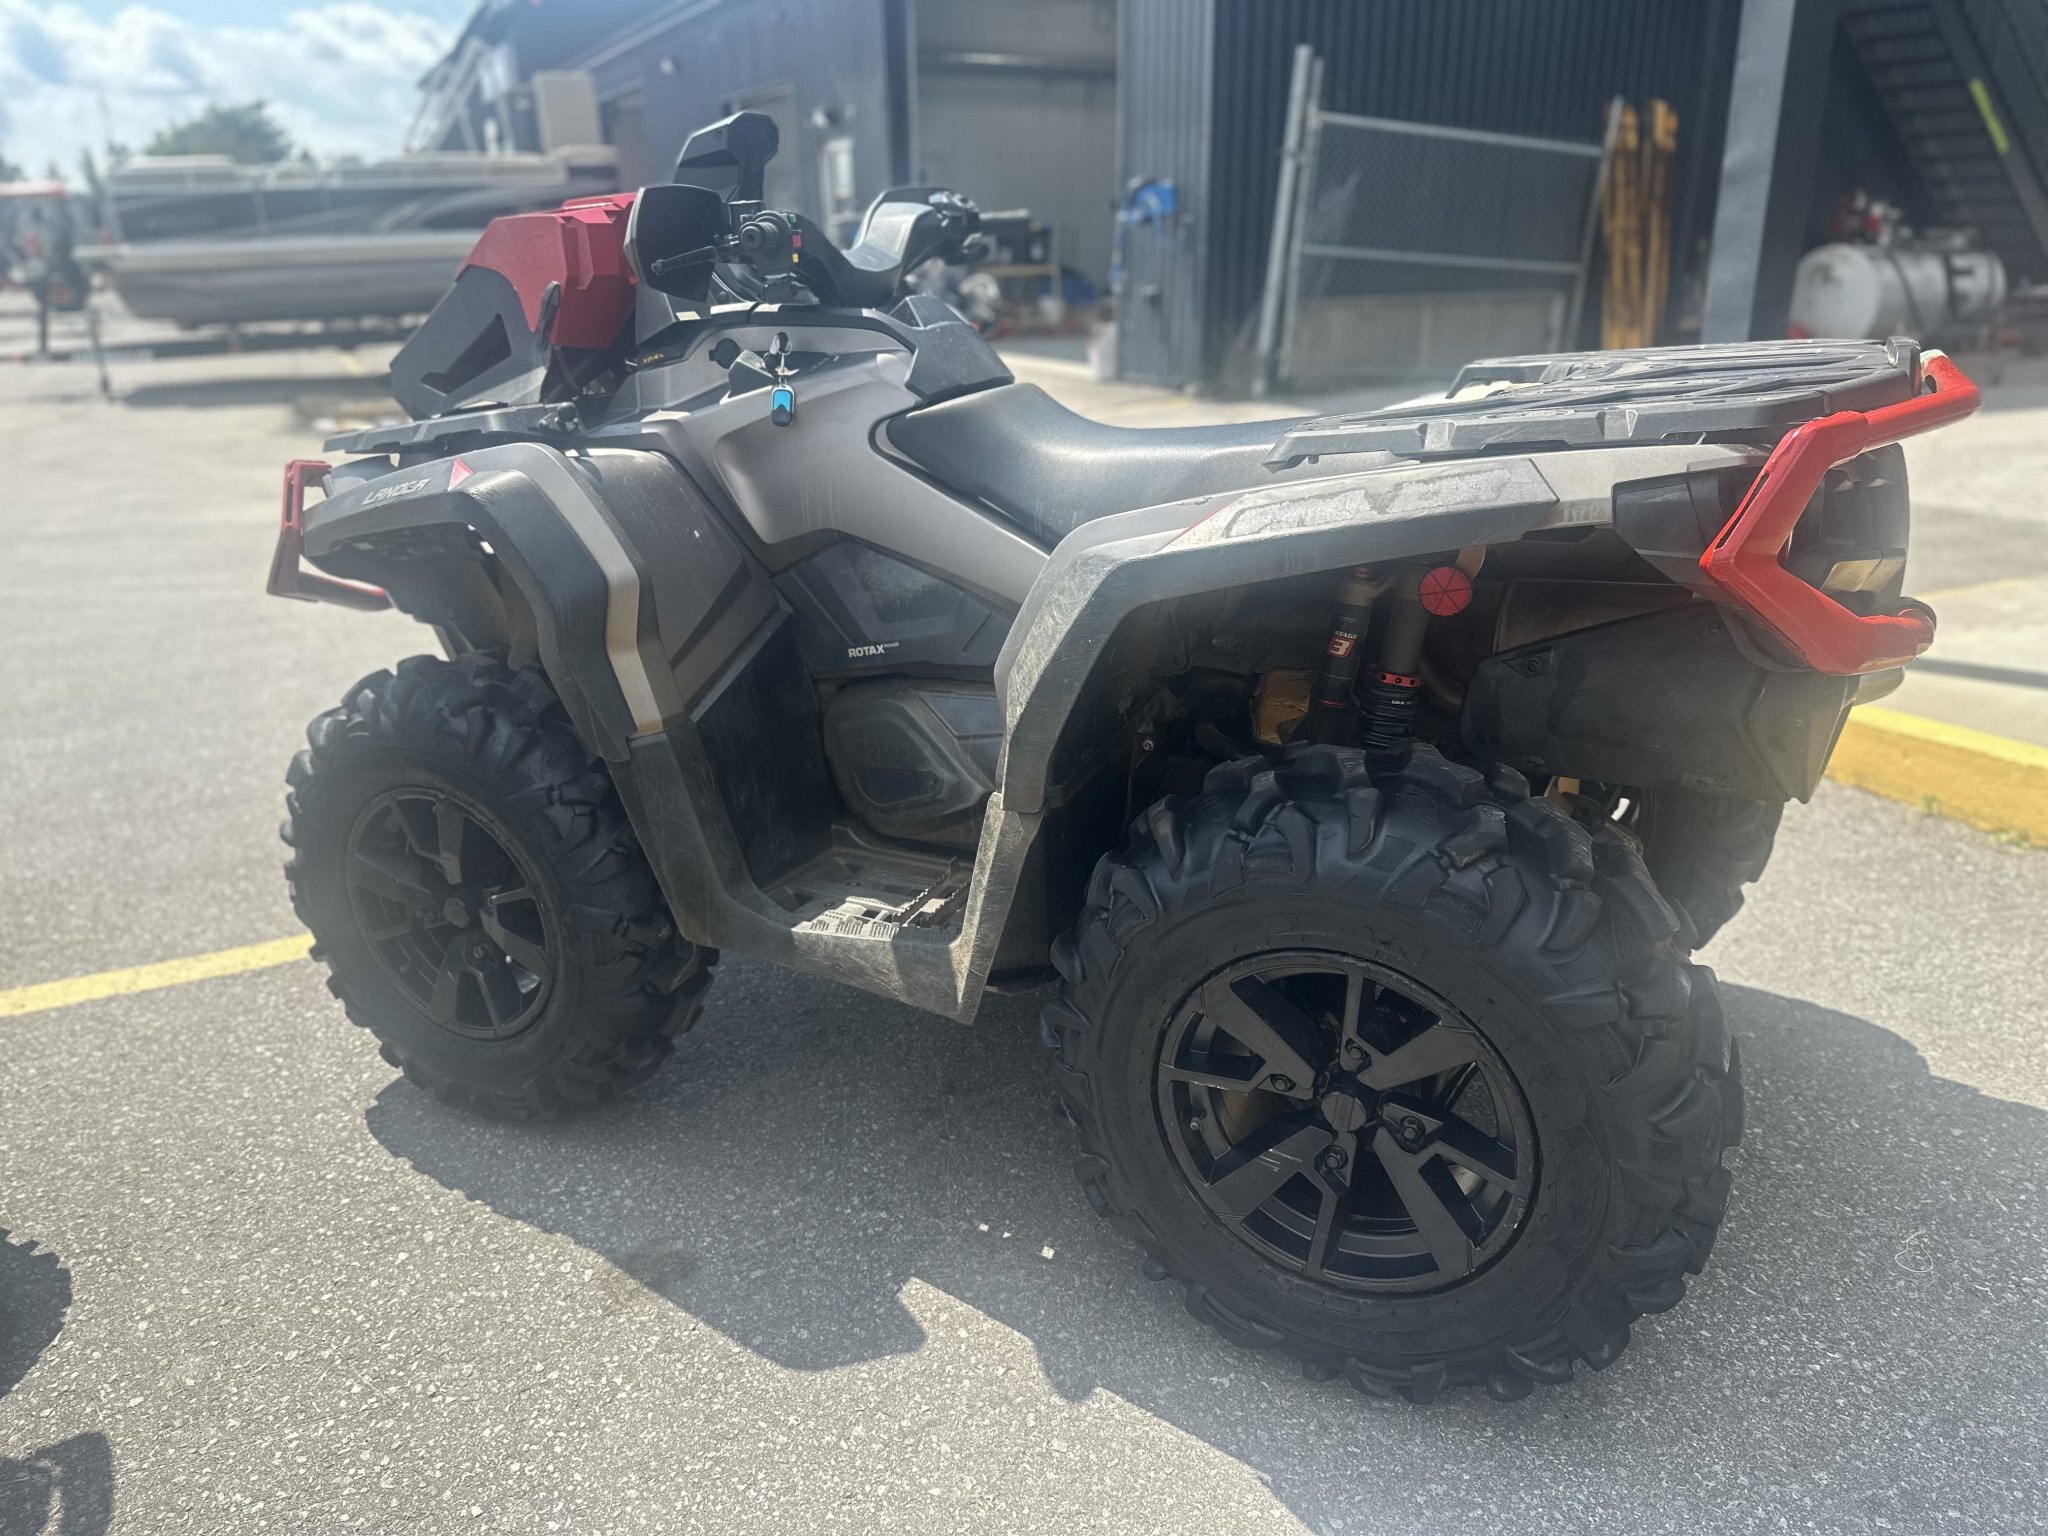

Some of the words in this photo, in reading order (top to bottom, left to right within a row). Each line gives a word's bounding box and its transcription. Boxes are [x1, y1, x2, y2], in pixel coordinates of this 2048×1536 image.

[1334, 630, 1358, 639] STAGE
[848, 644, 885, 658] ROTAX
[1329, 639, 1350, 656] 3
